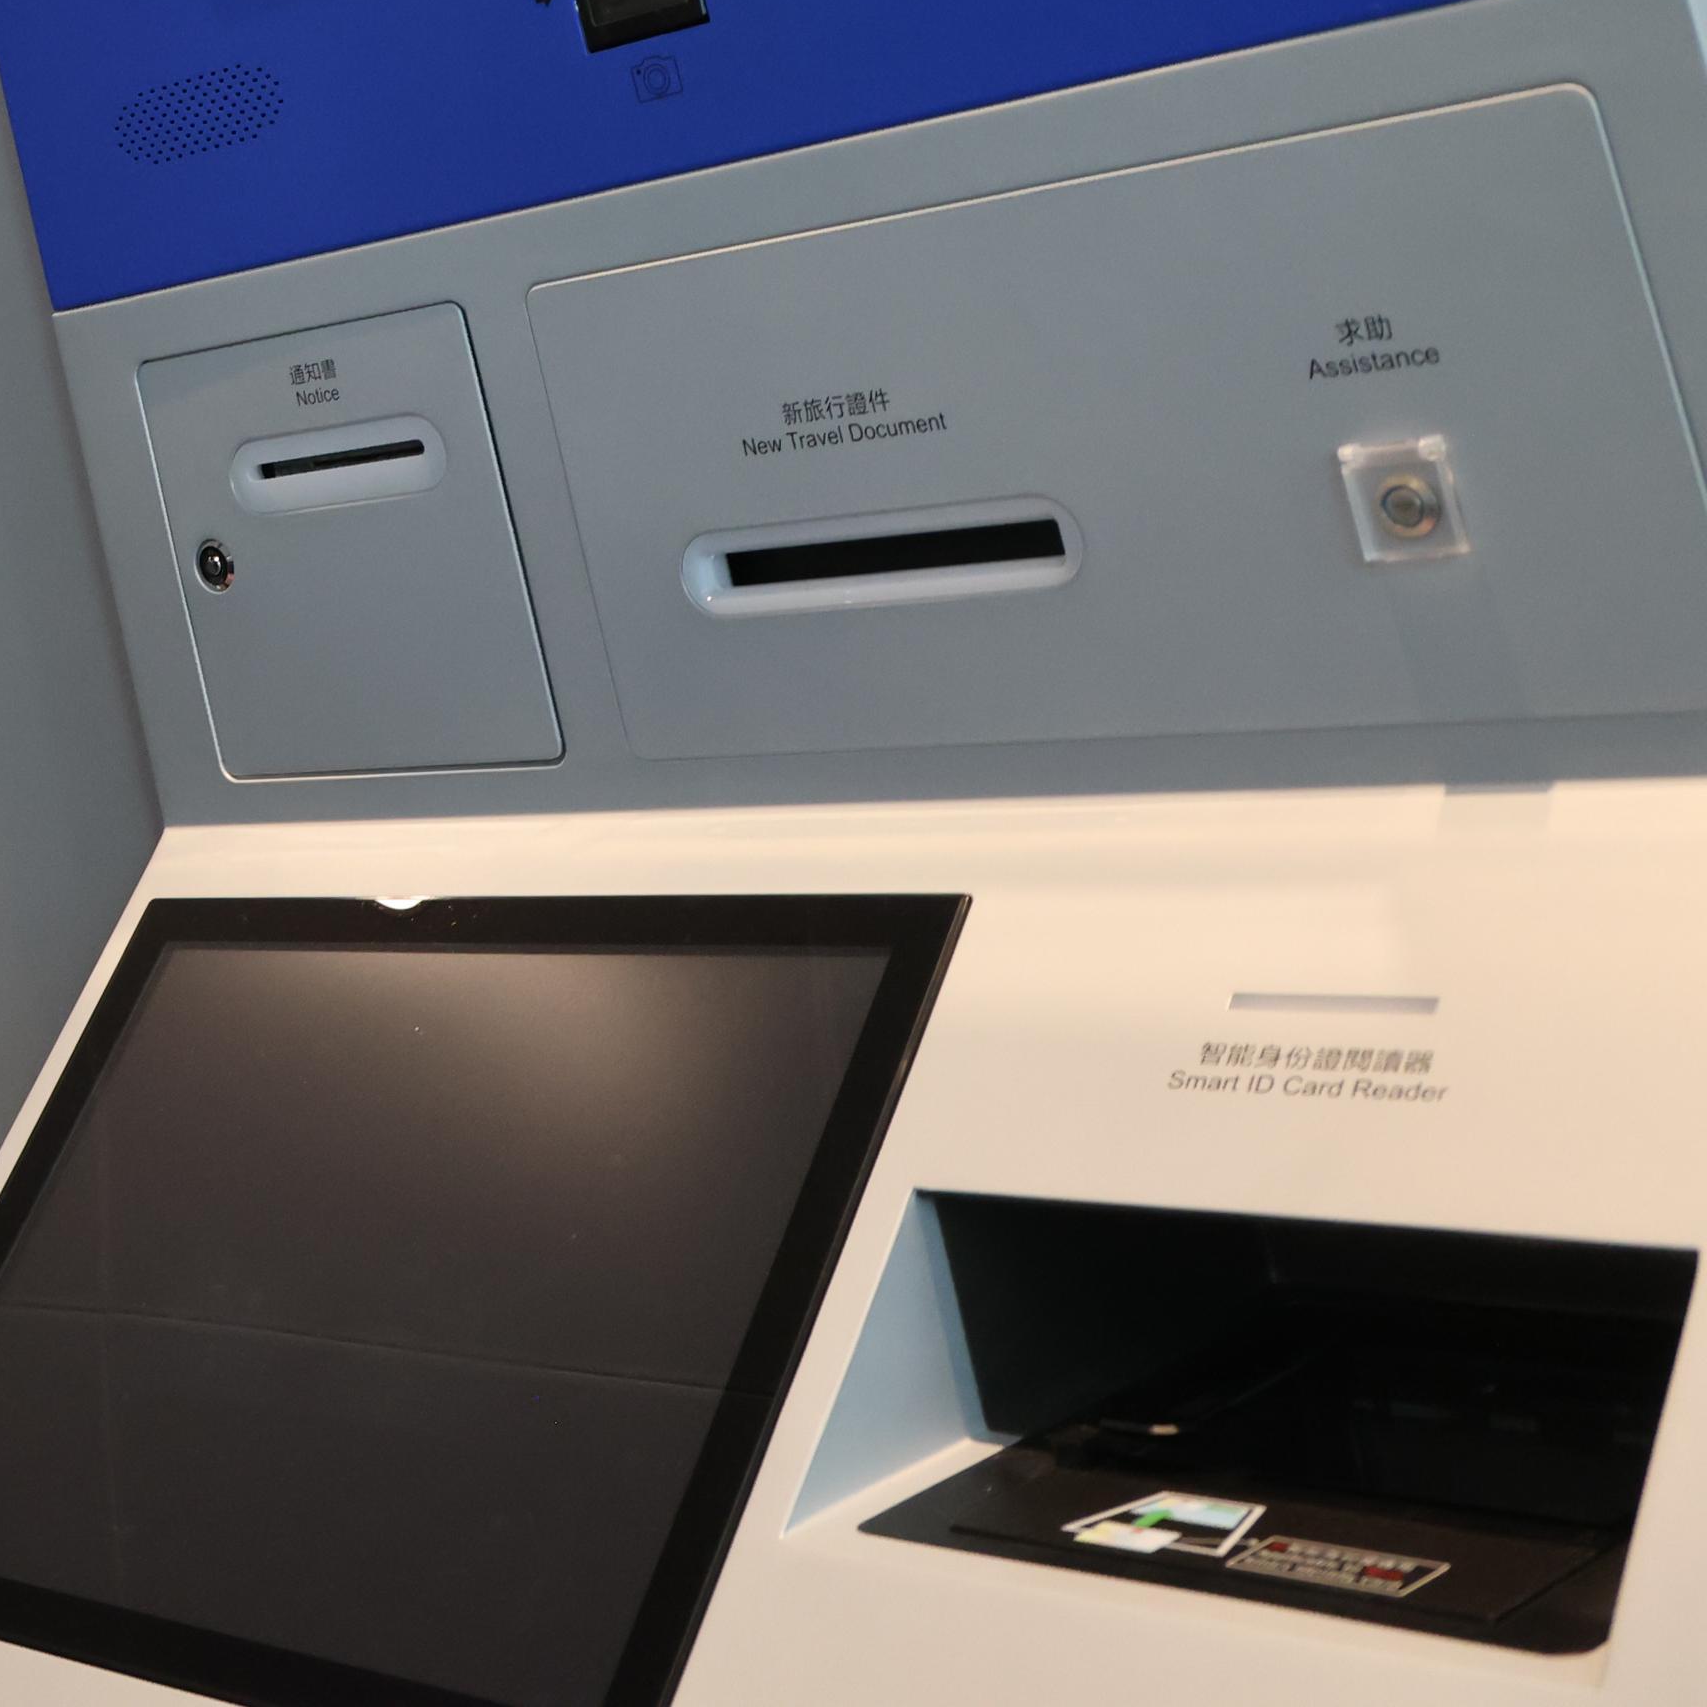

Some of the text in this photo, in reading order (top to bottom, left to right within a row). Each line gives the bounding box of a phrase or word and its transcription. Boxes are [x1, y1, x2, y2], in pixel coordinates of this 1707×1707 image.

[1336, 314, 1393, 346] 求助
[288, 358, 337, 387] 通知書
[1308, 345, 1440, 380] Assistance
[295, 386, 340, 407] Notice
[780, 388, 891, 426] 新旅行證件
[741, 412, 947, 457] New Travel Document
[1199, 1041, 1435, 1075] 智能身份證閱讀器
[1167, 1070, 1450, 1103] Smart ID Card Reader
